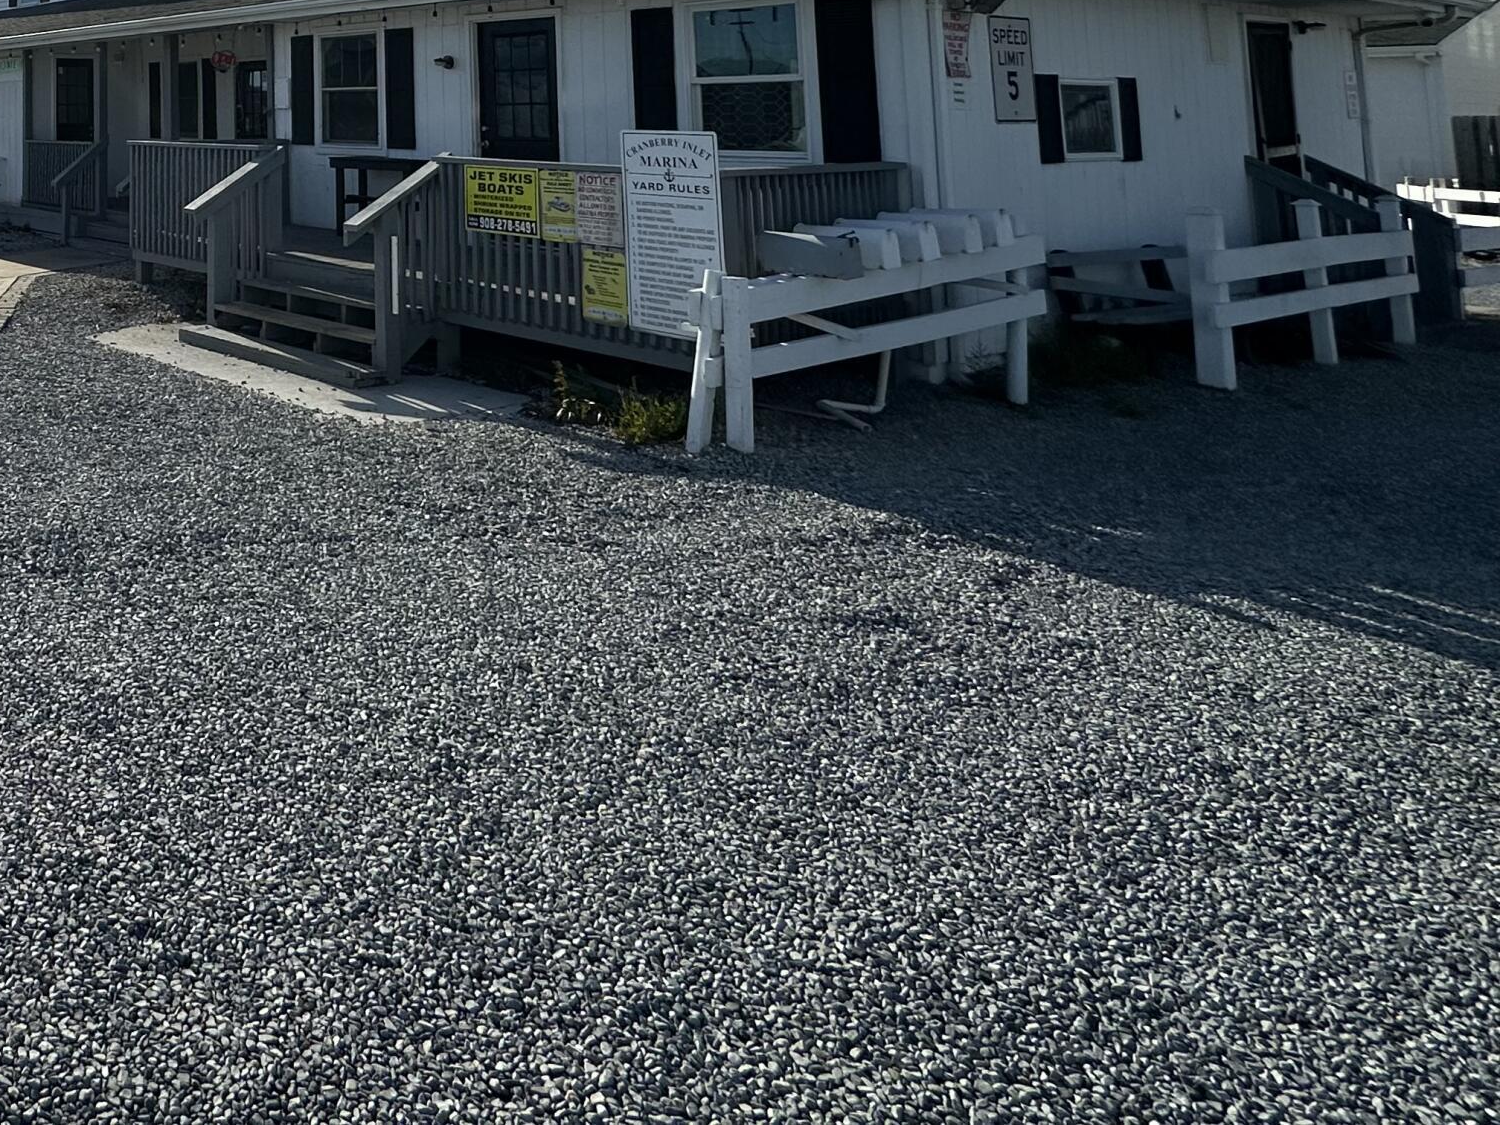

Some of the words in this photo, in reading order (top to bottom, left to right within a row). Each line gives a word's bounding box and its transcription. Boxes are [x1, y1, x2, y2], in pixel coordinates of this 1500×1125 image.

[992, 28, 1027, 45] SPEED
[997, 50, 1025, 66] LIMIT
[1006, 71, 1019, 100] 5
[626, 138, 679, 158] CRANBERRY
[682, 141, 712, 161] INLET
[640, 155, 698, 169] MARINA
[469, 171, 495, 181] JET
[499, 172, 533, 185] SKIS
[579, 175, 616, 186] NOTICE
[478, 183, 524, 195] BOATS
[632, 181, 664, 191] YARD
[669, 183, 710, 195] RULES
[474, 200, 497, 208] SHRINK
[500, 203, 533, 212] WRAPPED
[474, 207, 503, 215] STORAGE
[516, 211, 531, 219] SITE
[480, 216, 536, 235] 908-278-5491
